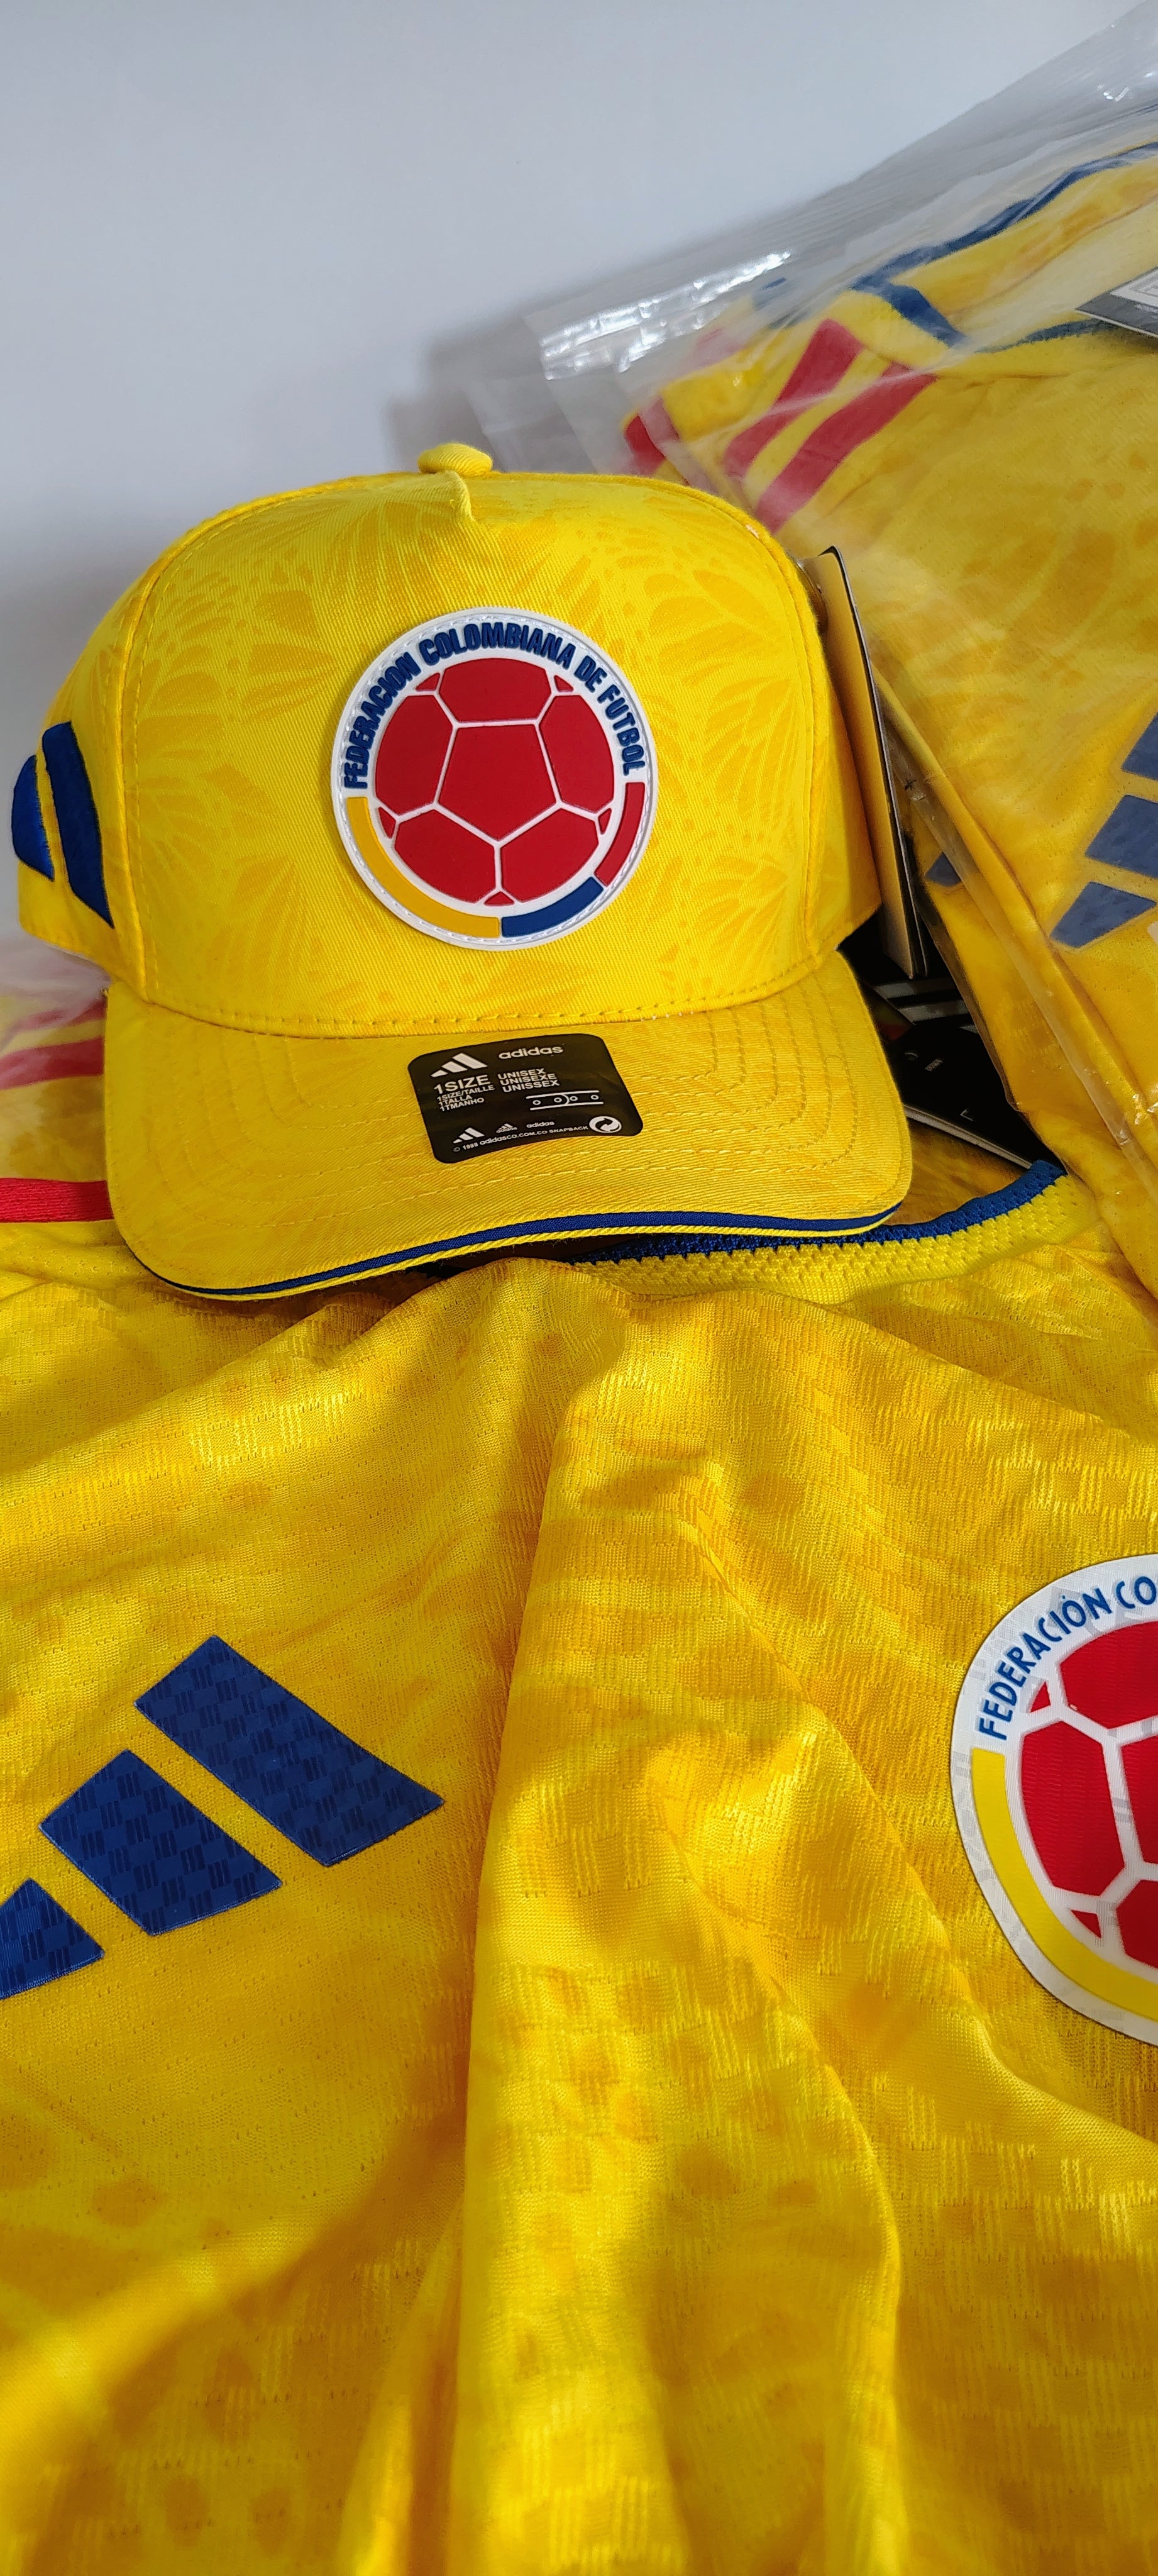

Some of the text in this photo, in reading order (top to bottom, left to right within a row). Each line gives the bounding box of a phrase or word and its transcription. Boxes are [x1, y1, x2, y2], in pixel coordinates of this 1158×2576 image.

[344, 622, 646, 789] FEDERACION COLOMBIANA DE FUTBOL
[499, 1046, 564, 1059] adidas
[497, 1068, 546, 1079] UNISEX
[500, 1073, 558, 1085] UNISEXE
[502, 1079, 561, 1092] UNISSEX
[548, 1126, 589, 1134] SNAPBACK
